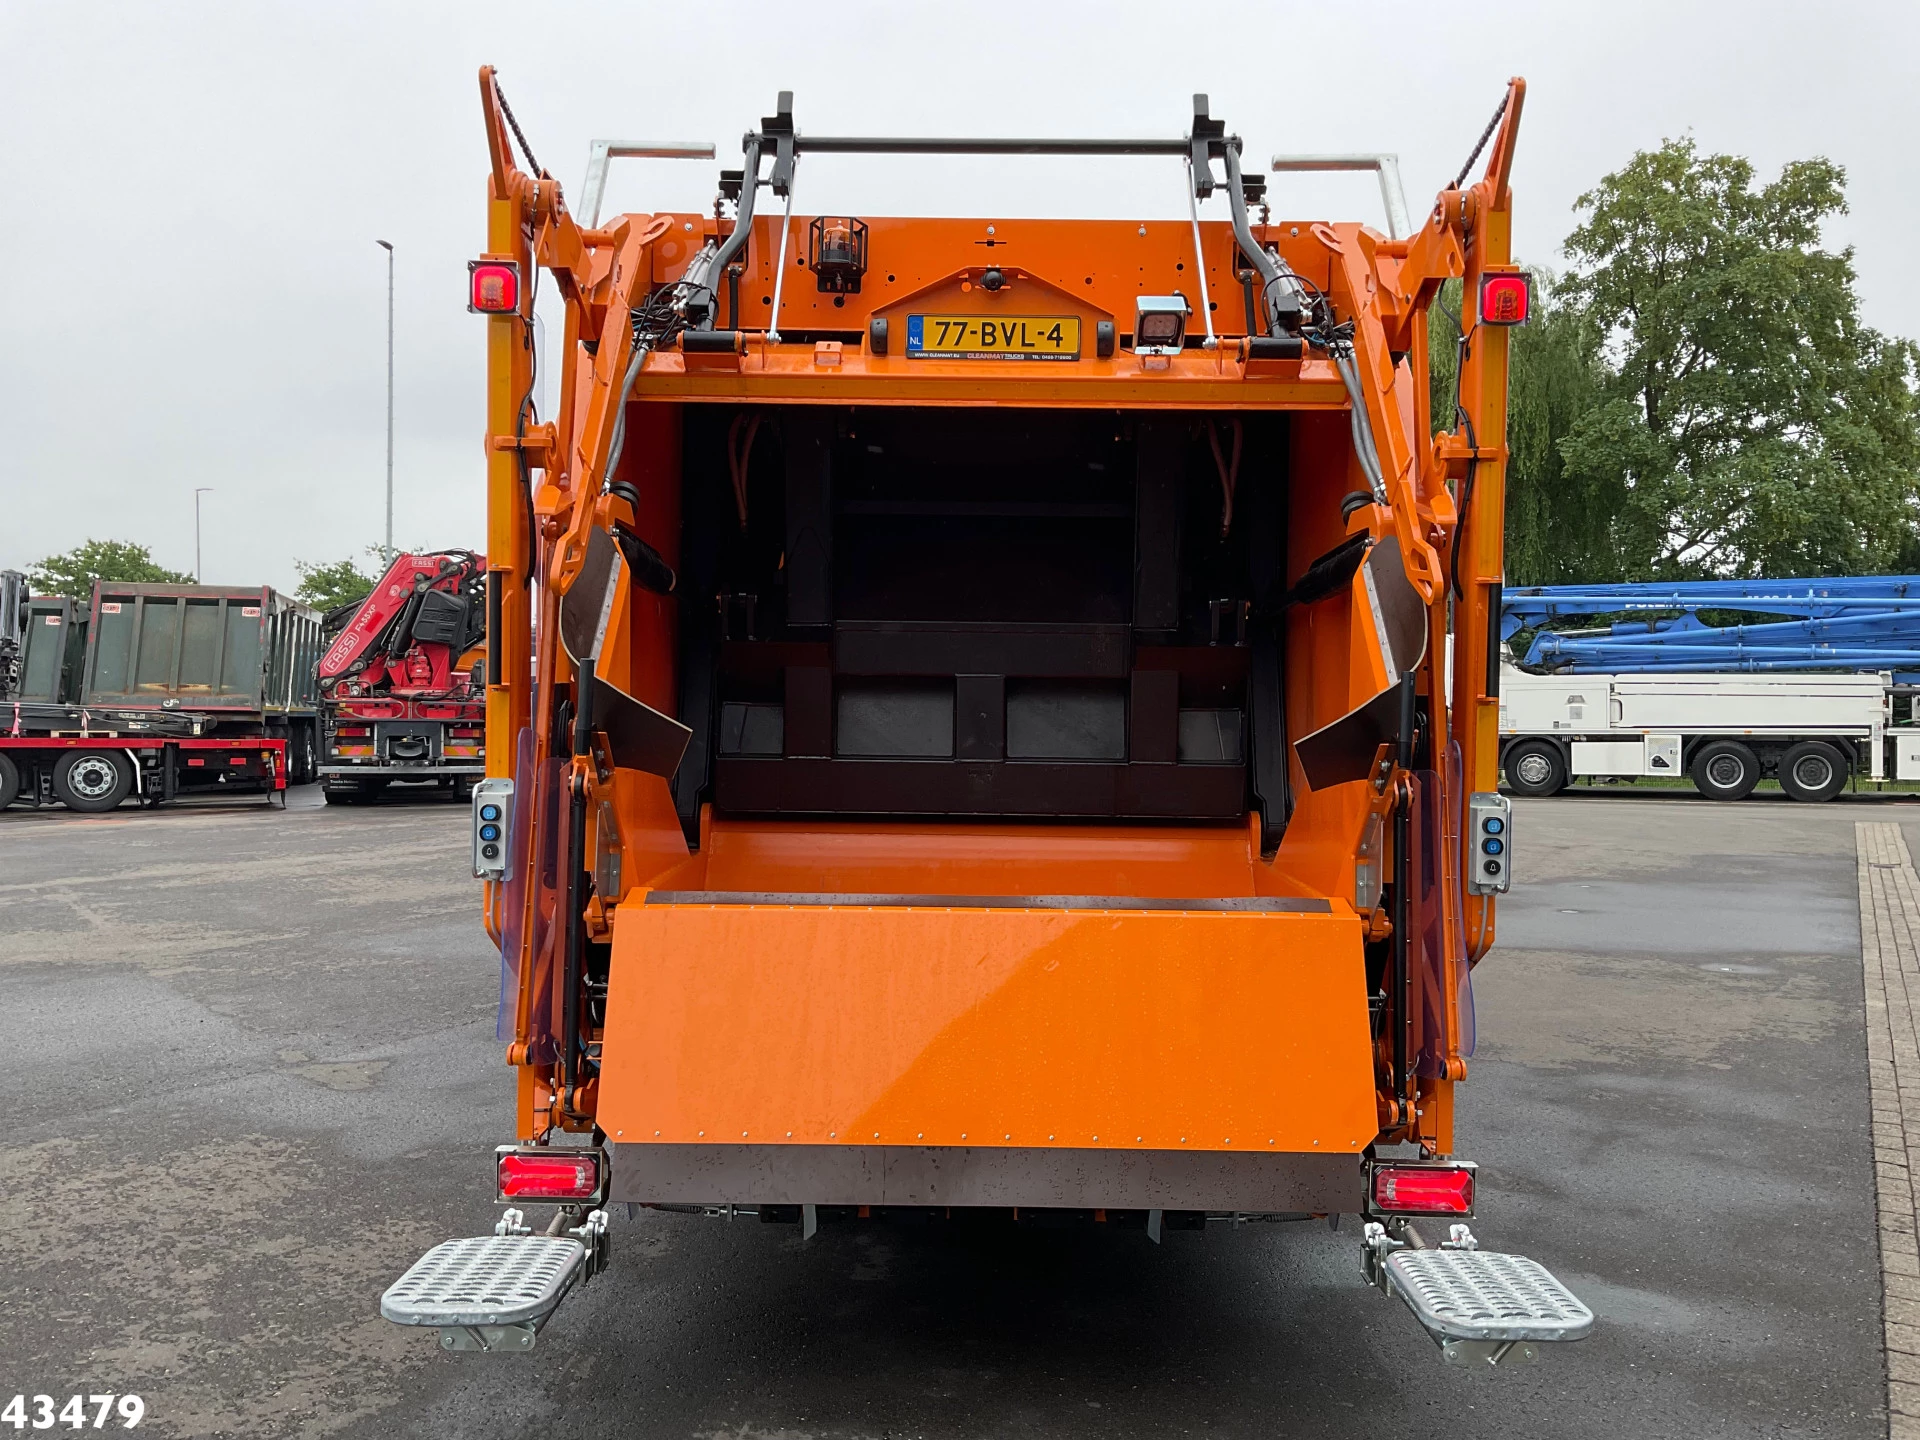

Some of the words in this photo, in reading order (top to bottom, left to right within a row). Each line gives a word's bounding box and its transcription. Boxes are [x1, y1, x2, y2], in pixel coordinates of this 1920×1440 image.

[909, 336, 921, 345] NL
[935, 321, 1063, 348] 77-BVL-4
[326, 635, 357, 670] FASSI
